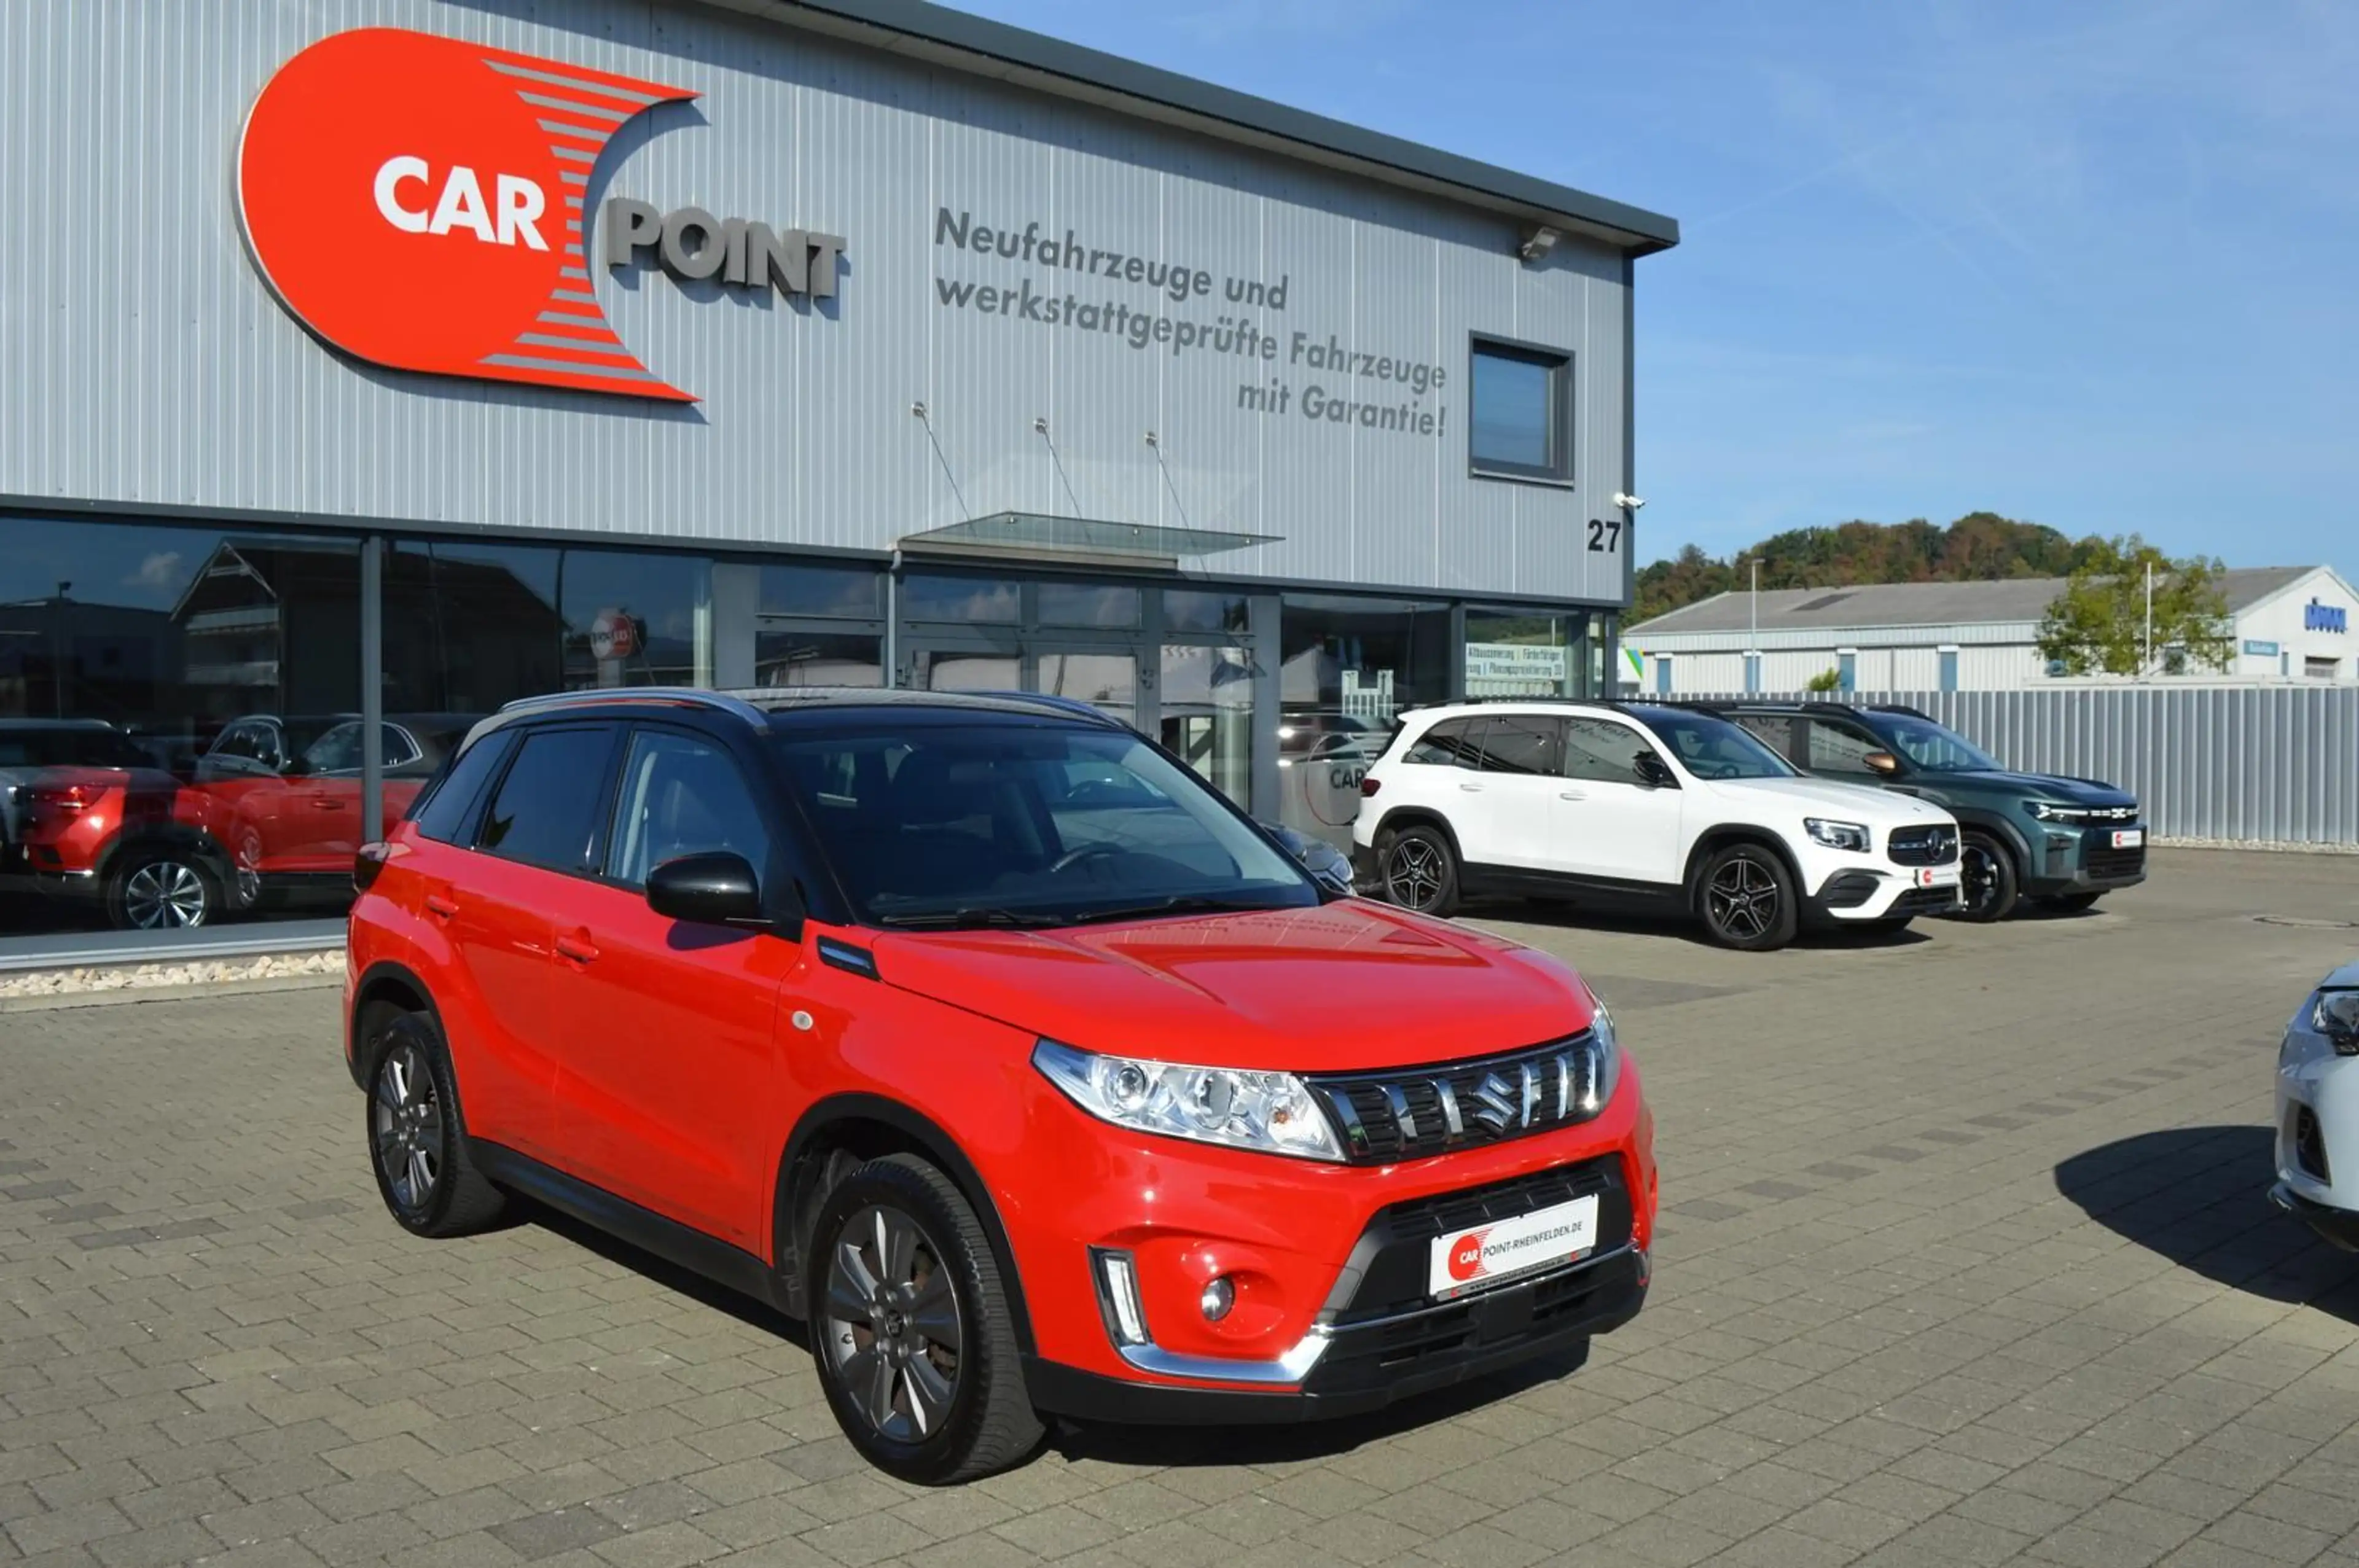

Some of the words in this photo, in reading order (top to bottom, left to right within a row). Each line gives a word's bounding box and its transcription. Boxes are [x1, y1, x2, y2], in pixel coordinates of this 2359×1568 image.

[374, 156, 550, 252] CAR
[606, 197, 847, 298] POINT
[936, 207, 1212, 302] Neufahrzeuge
[1225, 275, 1288, 310] und
[936, 277, 1277, 361] werkstattgeprüfte
[1291, 331, 1446, 395] Fahrzeuge
[1238, 377, 1291, 414] mit
[1301, 385, 1446, 437] Garantie!
[1588, 518, 1621, 553] 27
[1331, 768, 1365, 789] CAR
[1460, 1249, 1478, 1265] CAR
[1483, 1221, 1583, 1258] POINT-RHEINFELDEN.DE
